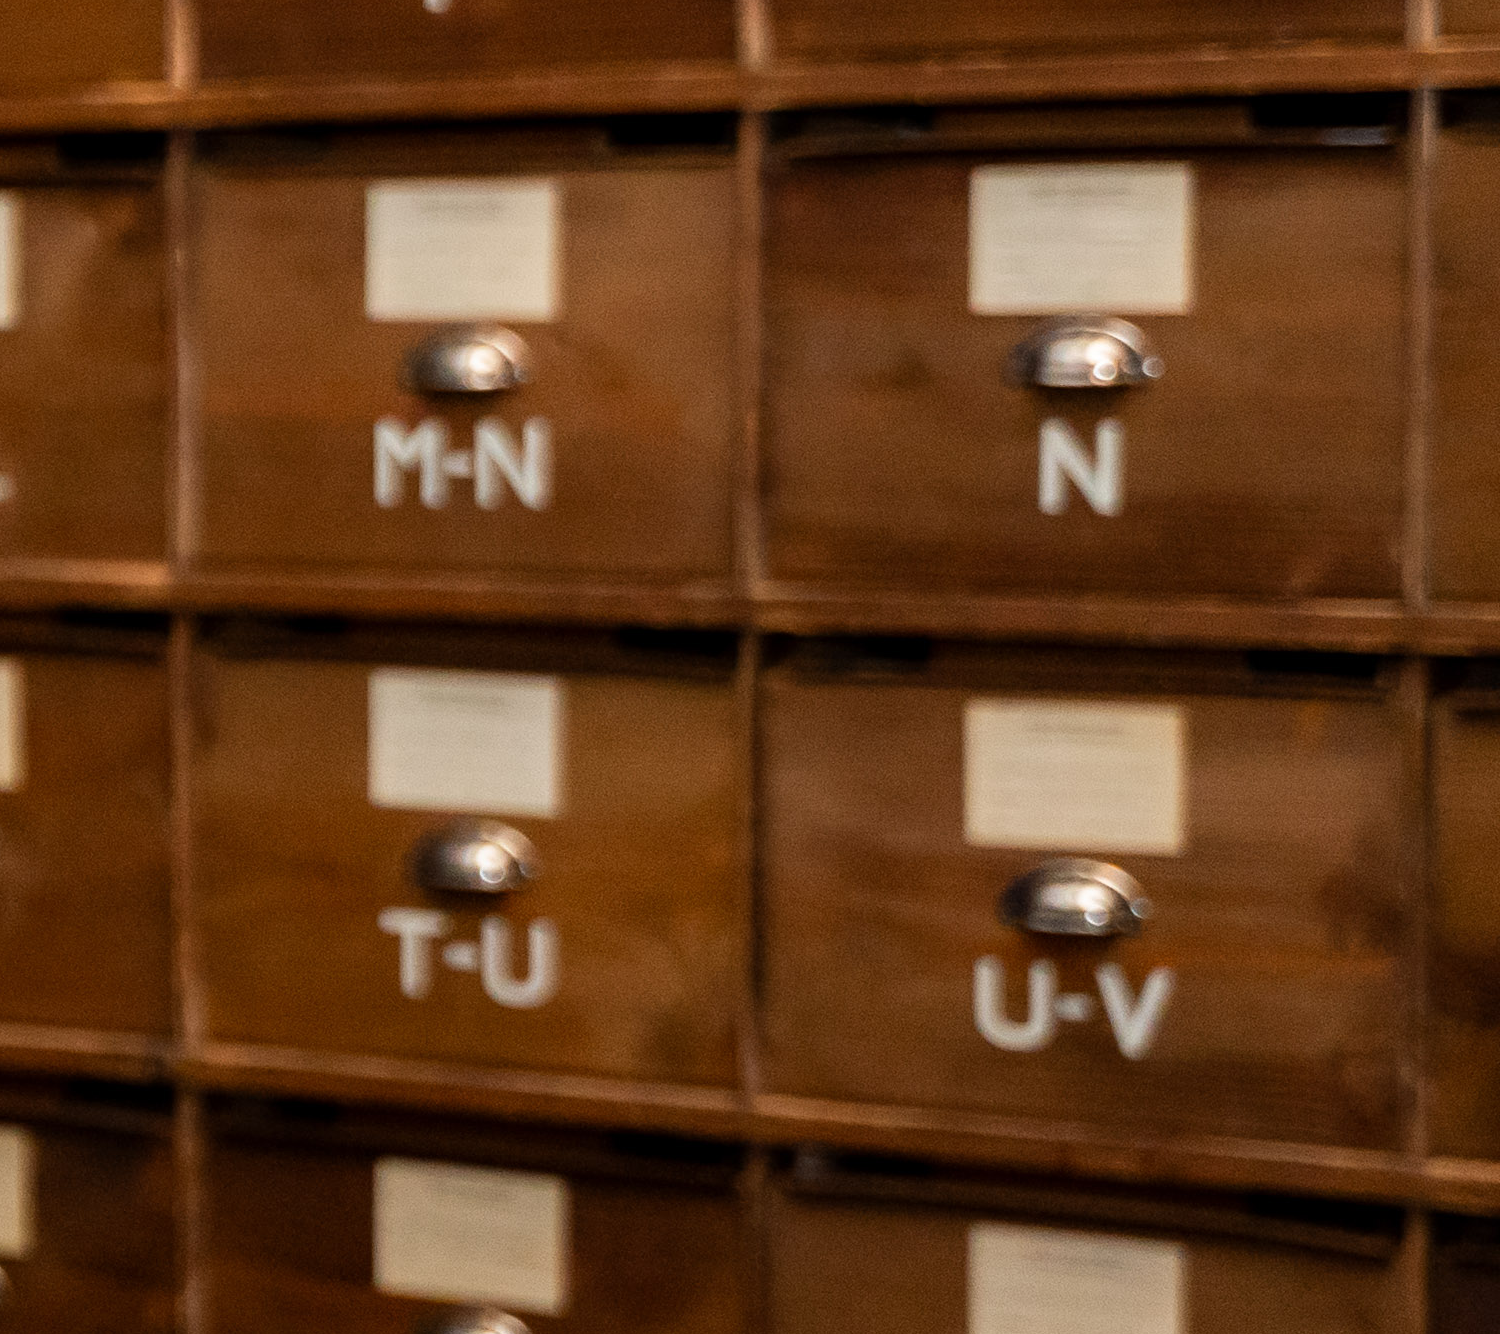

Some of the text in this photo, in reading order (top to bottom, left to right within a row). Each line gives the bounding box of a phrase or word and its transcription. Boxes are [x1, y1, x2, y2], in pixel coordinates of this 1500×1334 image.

[375, 419, 549, 508] M-N
[1039, 421, 1122, 514] N
[380, 909, 556, 1006] T-U
[974, 958, 1172, 1057] U-V
